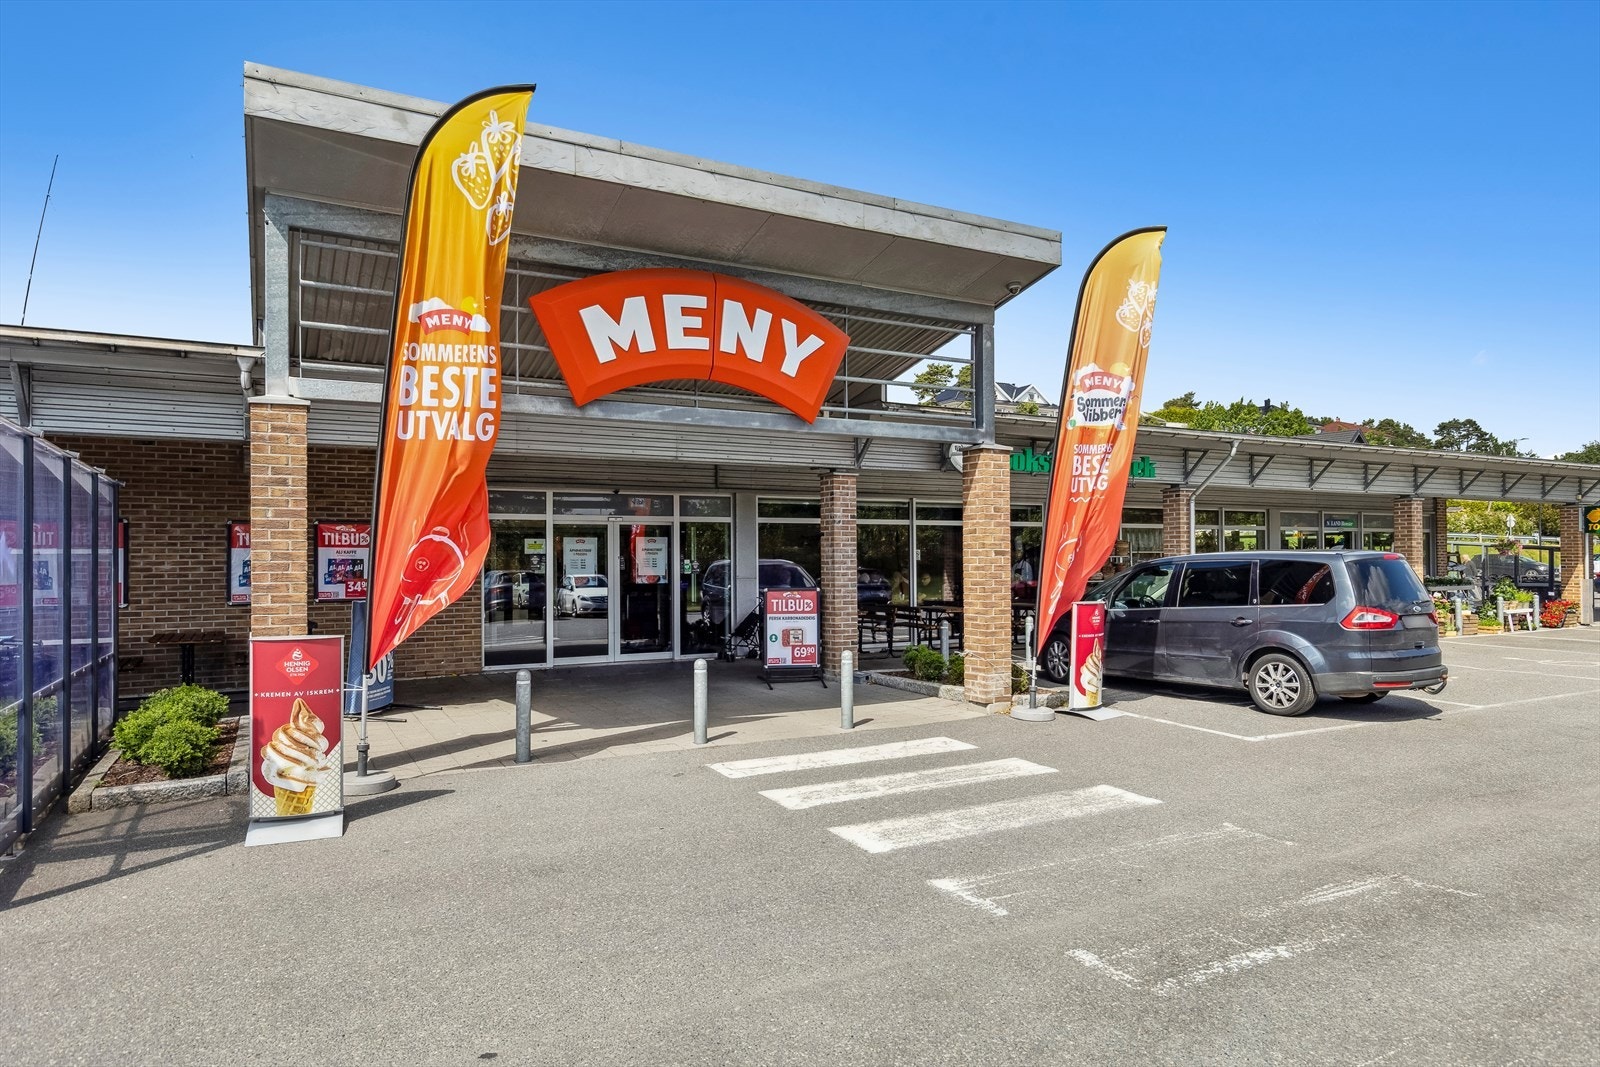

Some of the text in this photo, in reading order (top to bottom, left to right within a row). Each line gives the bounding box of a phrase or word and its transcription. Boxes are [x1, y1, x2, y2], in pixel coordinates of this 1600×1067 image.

[425, 313, 473, 329] MENY
[578, 294, 825, 378] MENY
[402, 342, 497, 364] SOMMERENS
[399, 365, 497, 409] BESTE
[1084, 375, 1122, 389] MENY
[1083, 407, 1122, 422] Vibber
[397, 410, 495, 441] UTVALG
[1072, 453, 1112, 476] BESE
[1070, 475, 1109, 493] UTVG
[771, 599, 814, 612] TILBUD
[283, 660, 311, 668] HENNIG
